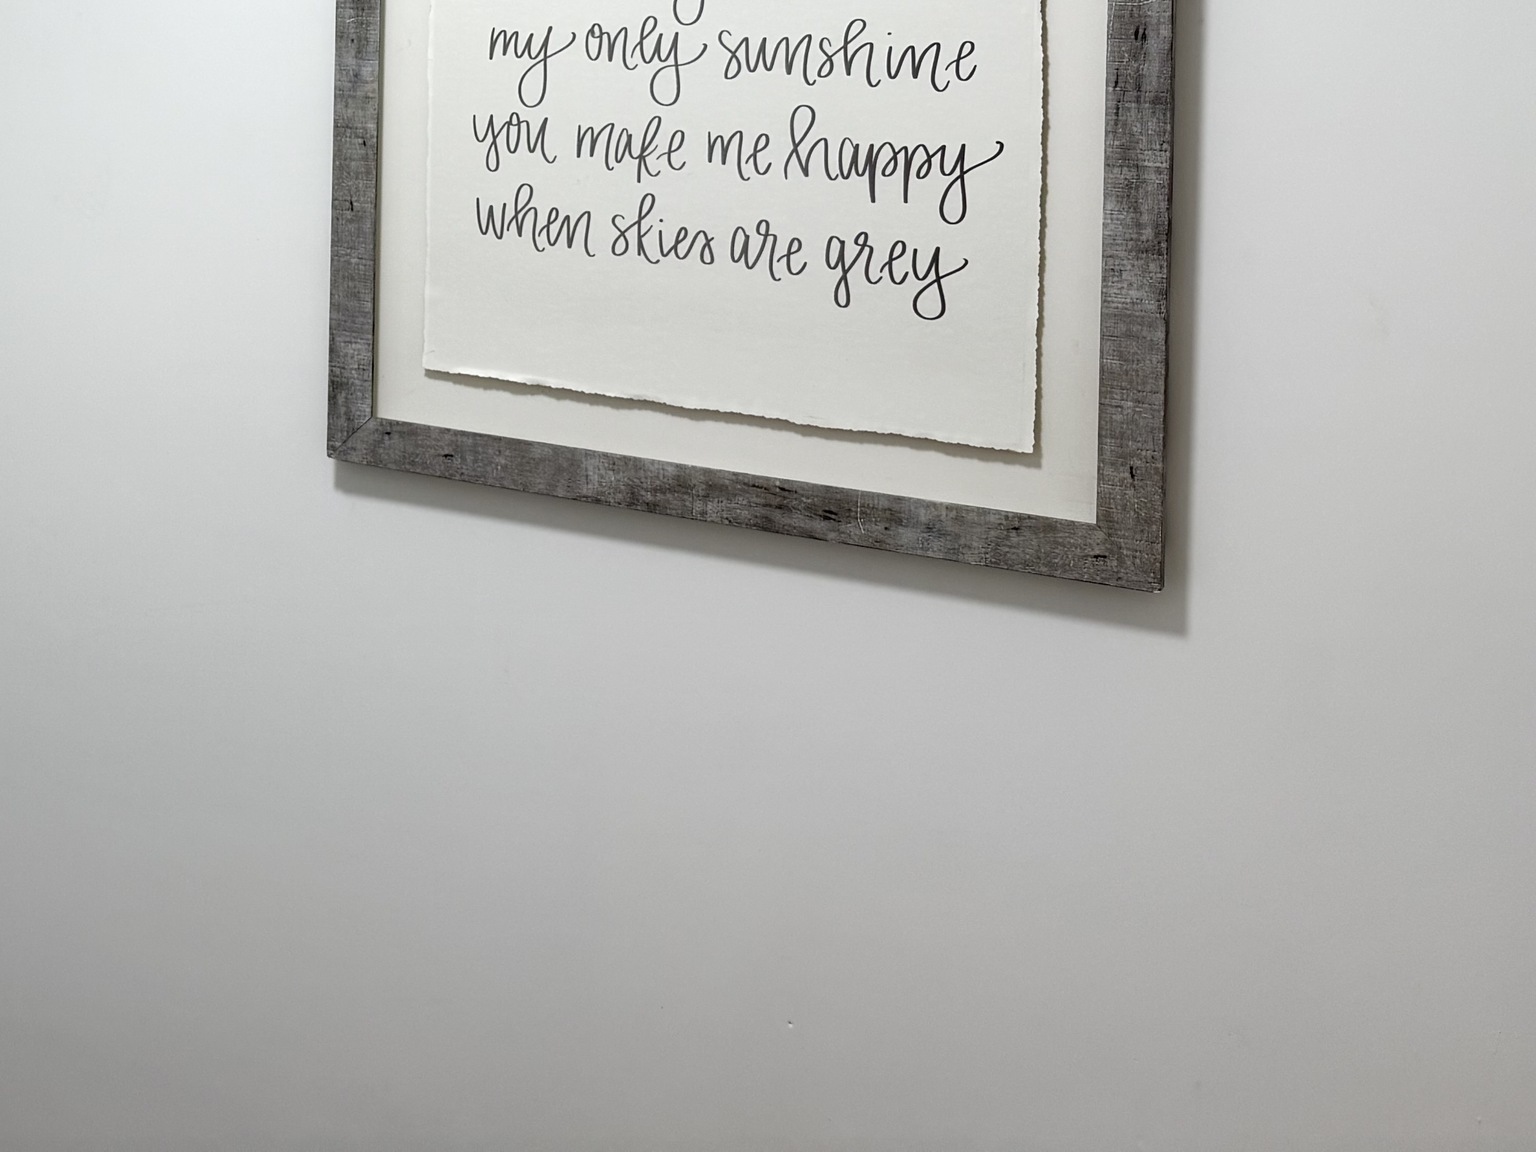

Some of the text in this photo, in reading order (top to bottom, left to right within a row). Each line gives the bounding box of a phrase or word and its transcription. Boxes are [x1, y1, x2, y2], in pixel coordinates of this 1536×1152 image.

[489, 15, 978, 109] my only sunshine
[472, 104, 1005, 225] you make me happy
[476, 183, 969, 321] when skies are grey
